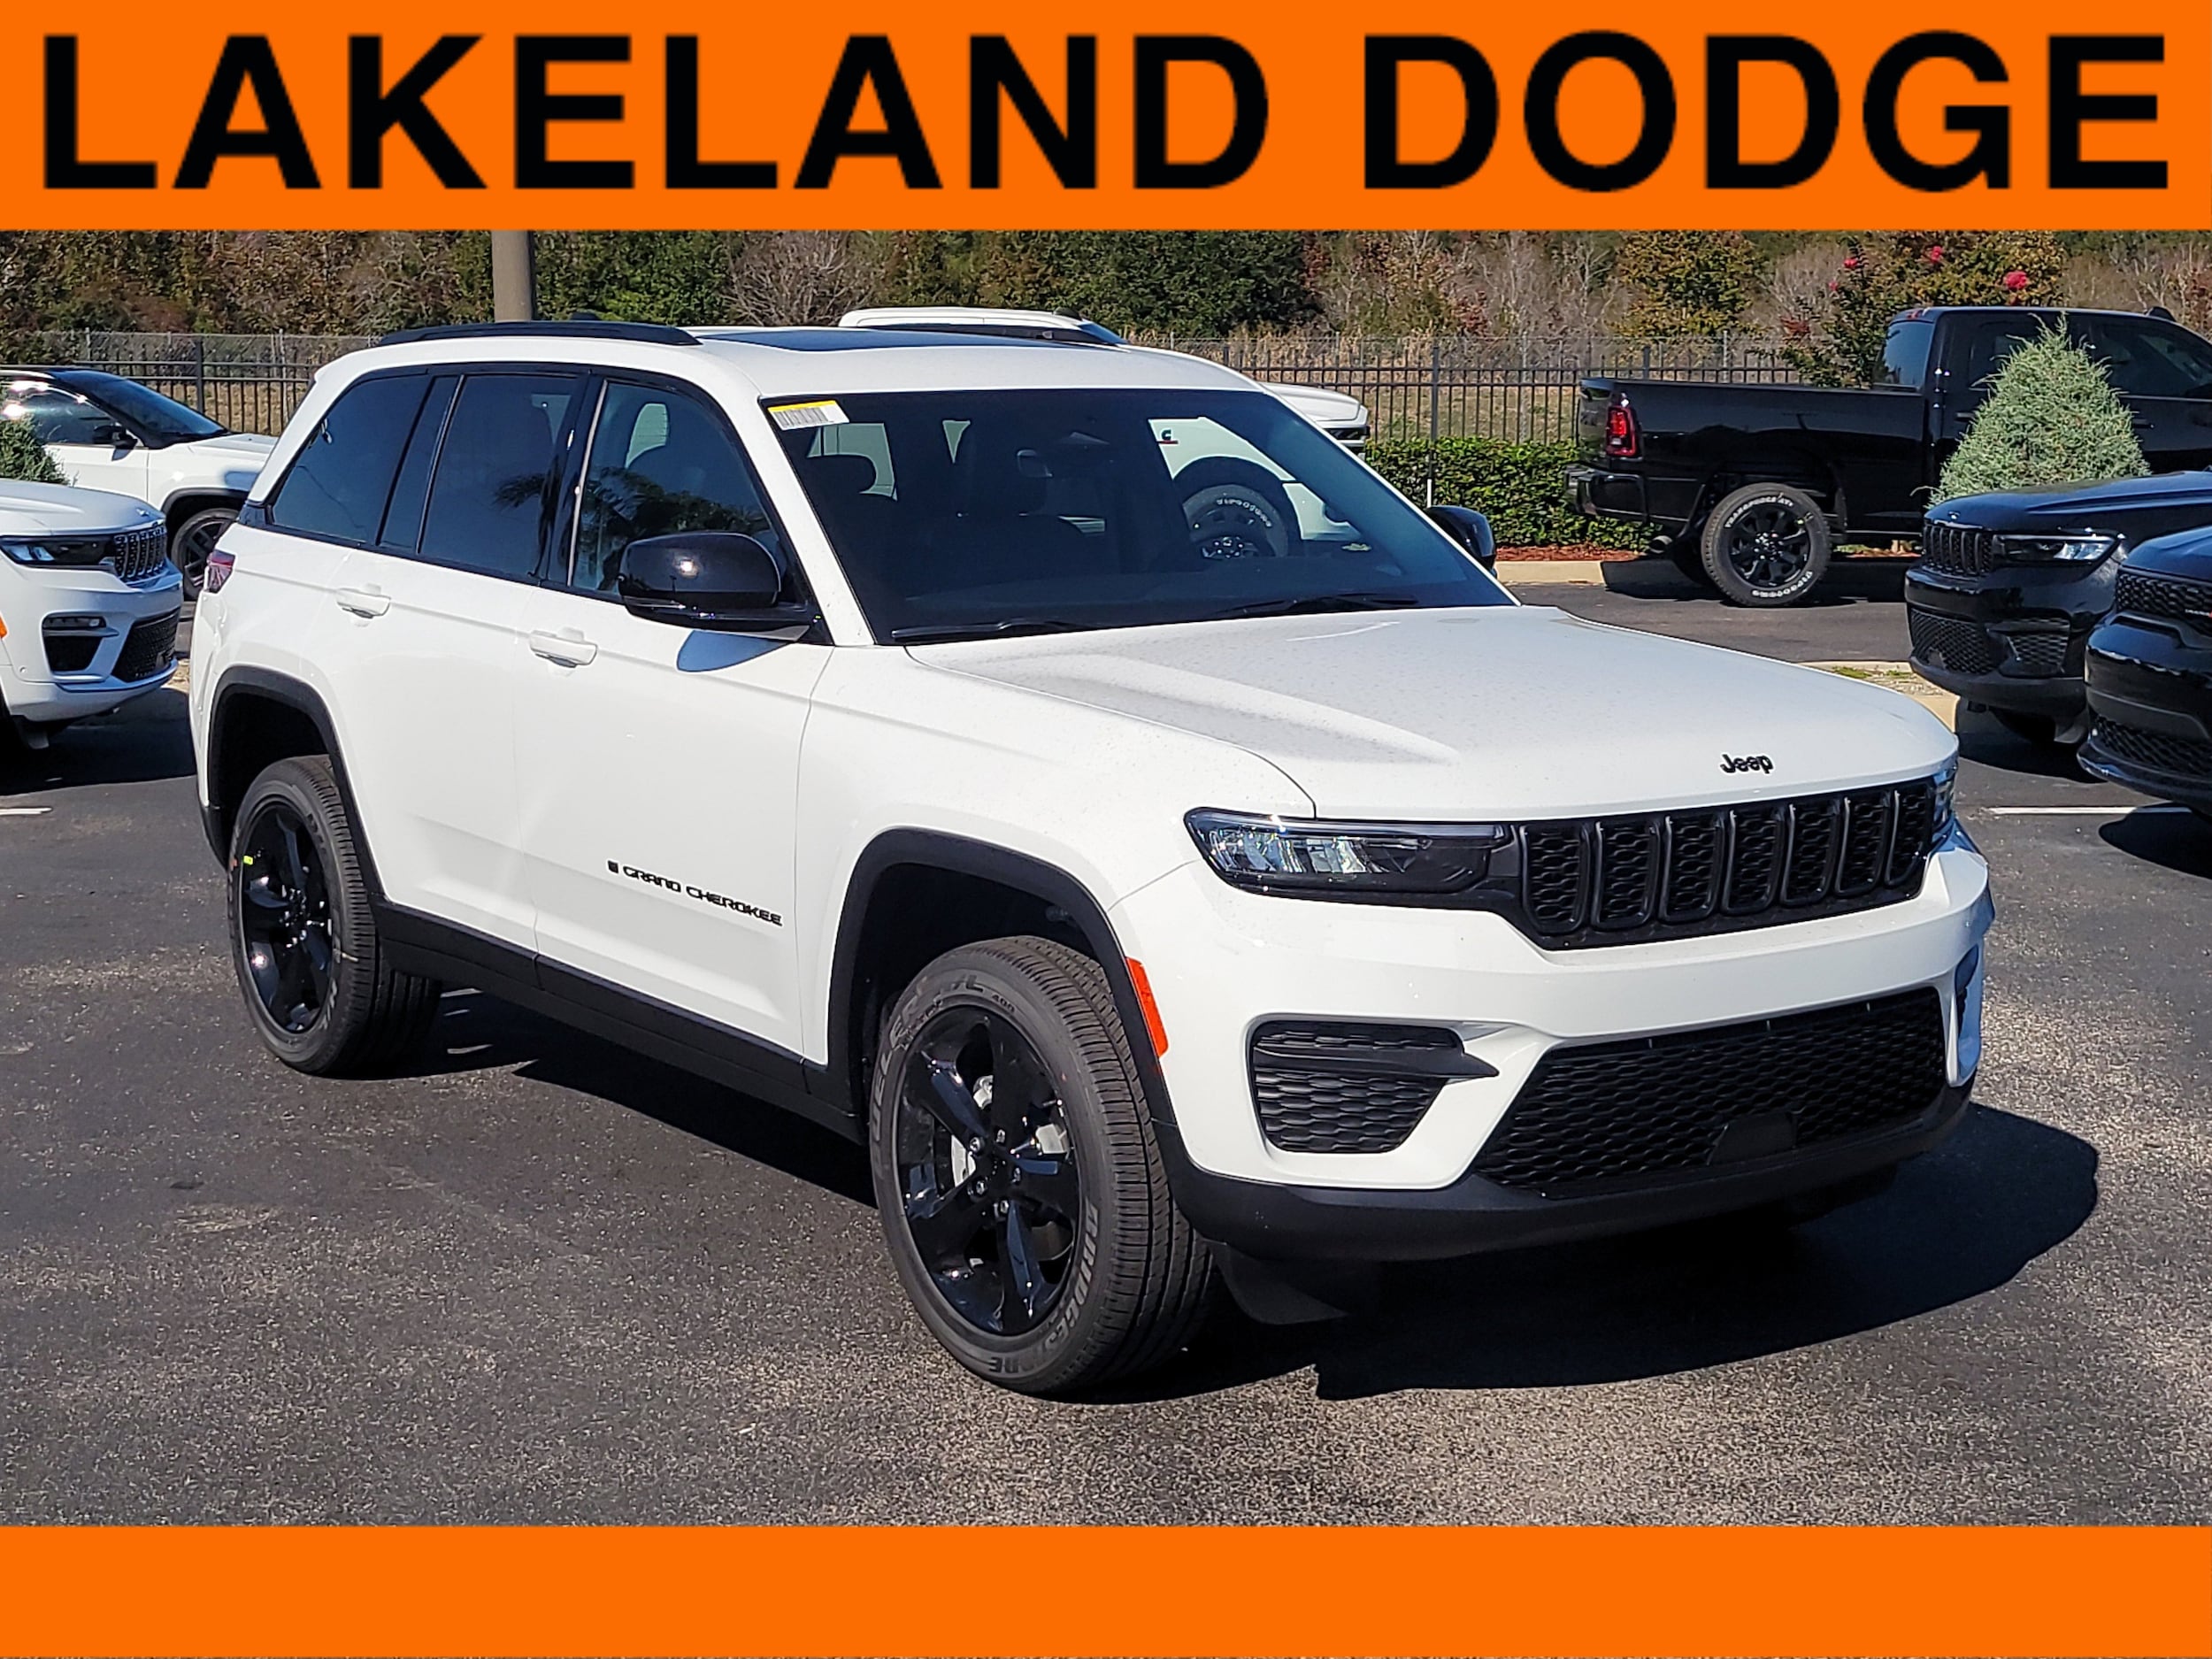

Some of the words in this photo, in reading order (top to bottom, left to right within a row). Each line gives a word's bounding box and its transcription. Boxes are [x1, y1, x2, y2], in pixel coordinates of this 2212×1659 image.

[1720, 753, 1774, 774] Jeep
[622, 864, 681, 894] GRAND
[686, 885, 783, 927] CHEROKEE
[991, 994, 1015, 1014] 400
